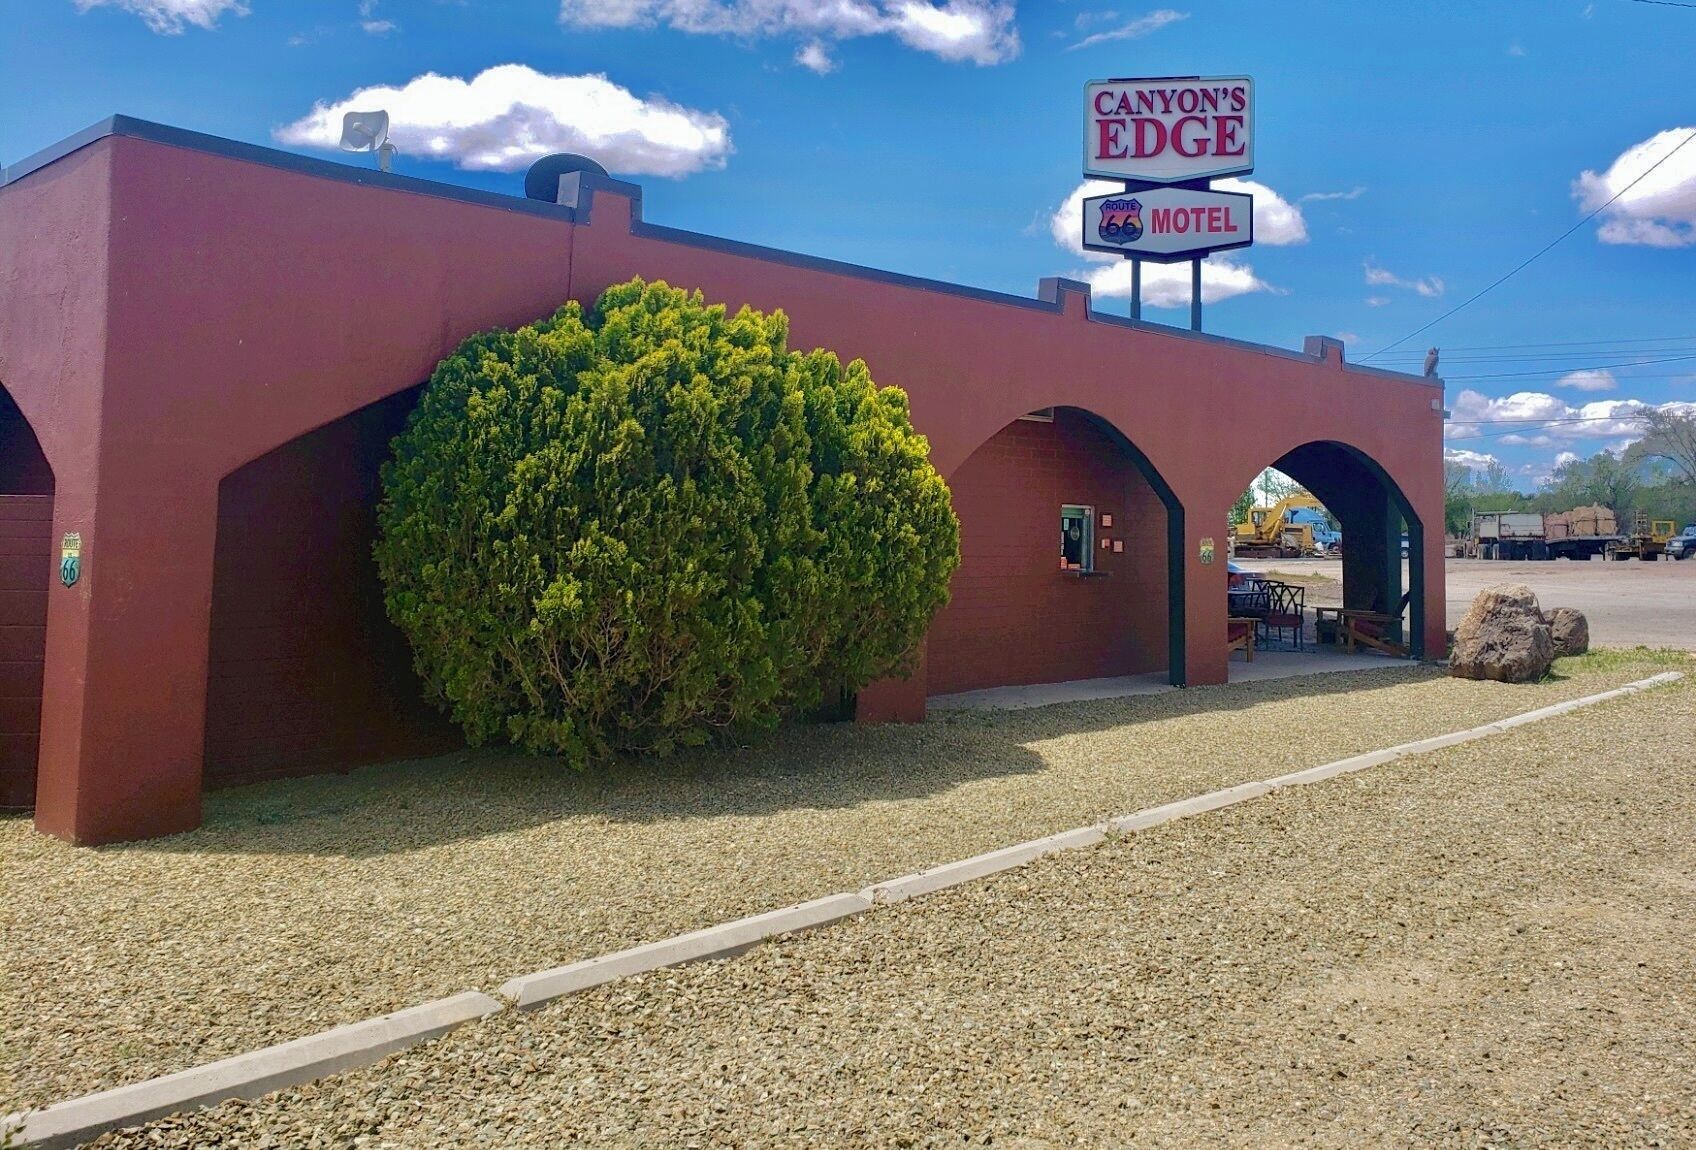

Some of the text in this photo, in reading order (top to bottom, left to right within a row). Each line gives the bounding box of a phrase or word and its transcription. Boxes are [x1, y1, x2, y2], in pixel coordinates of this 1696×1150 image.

[1094, 87, 1246, 116] CANYON'S
[1095, 115, 1245, 159] EDGE
[1105, 202, 1137, 211] ROUTE
[1105, 214, 1137, 236] 66
[1151, 207, 1238, 234] MOTEL
[63, 560, 75, 581] 66
